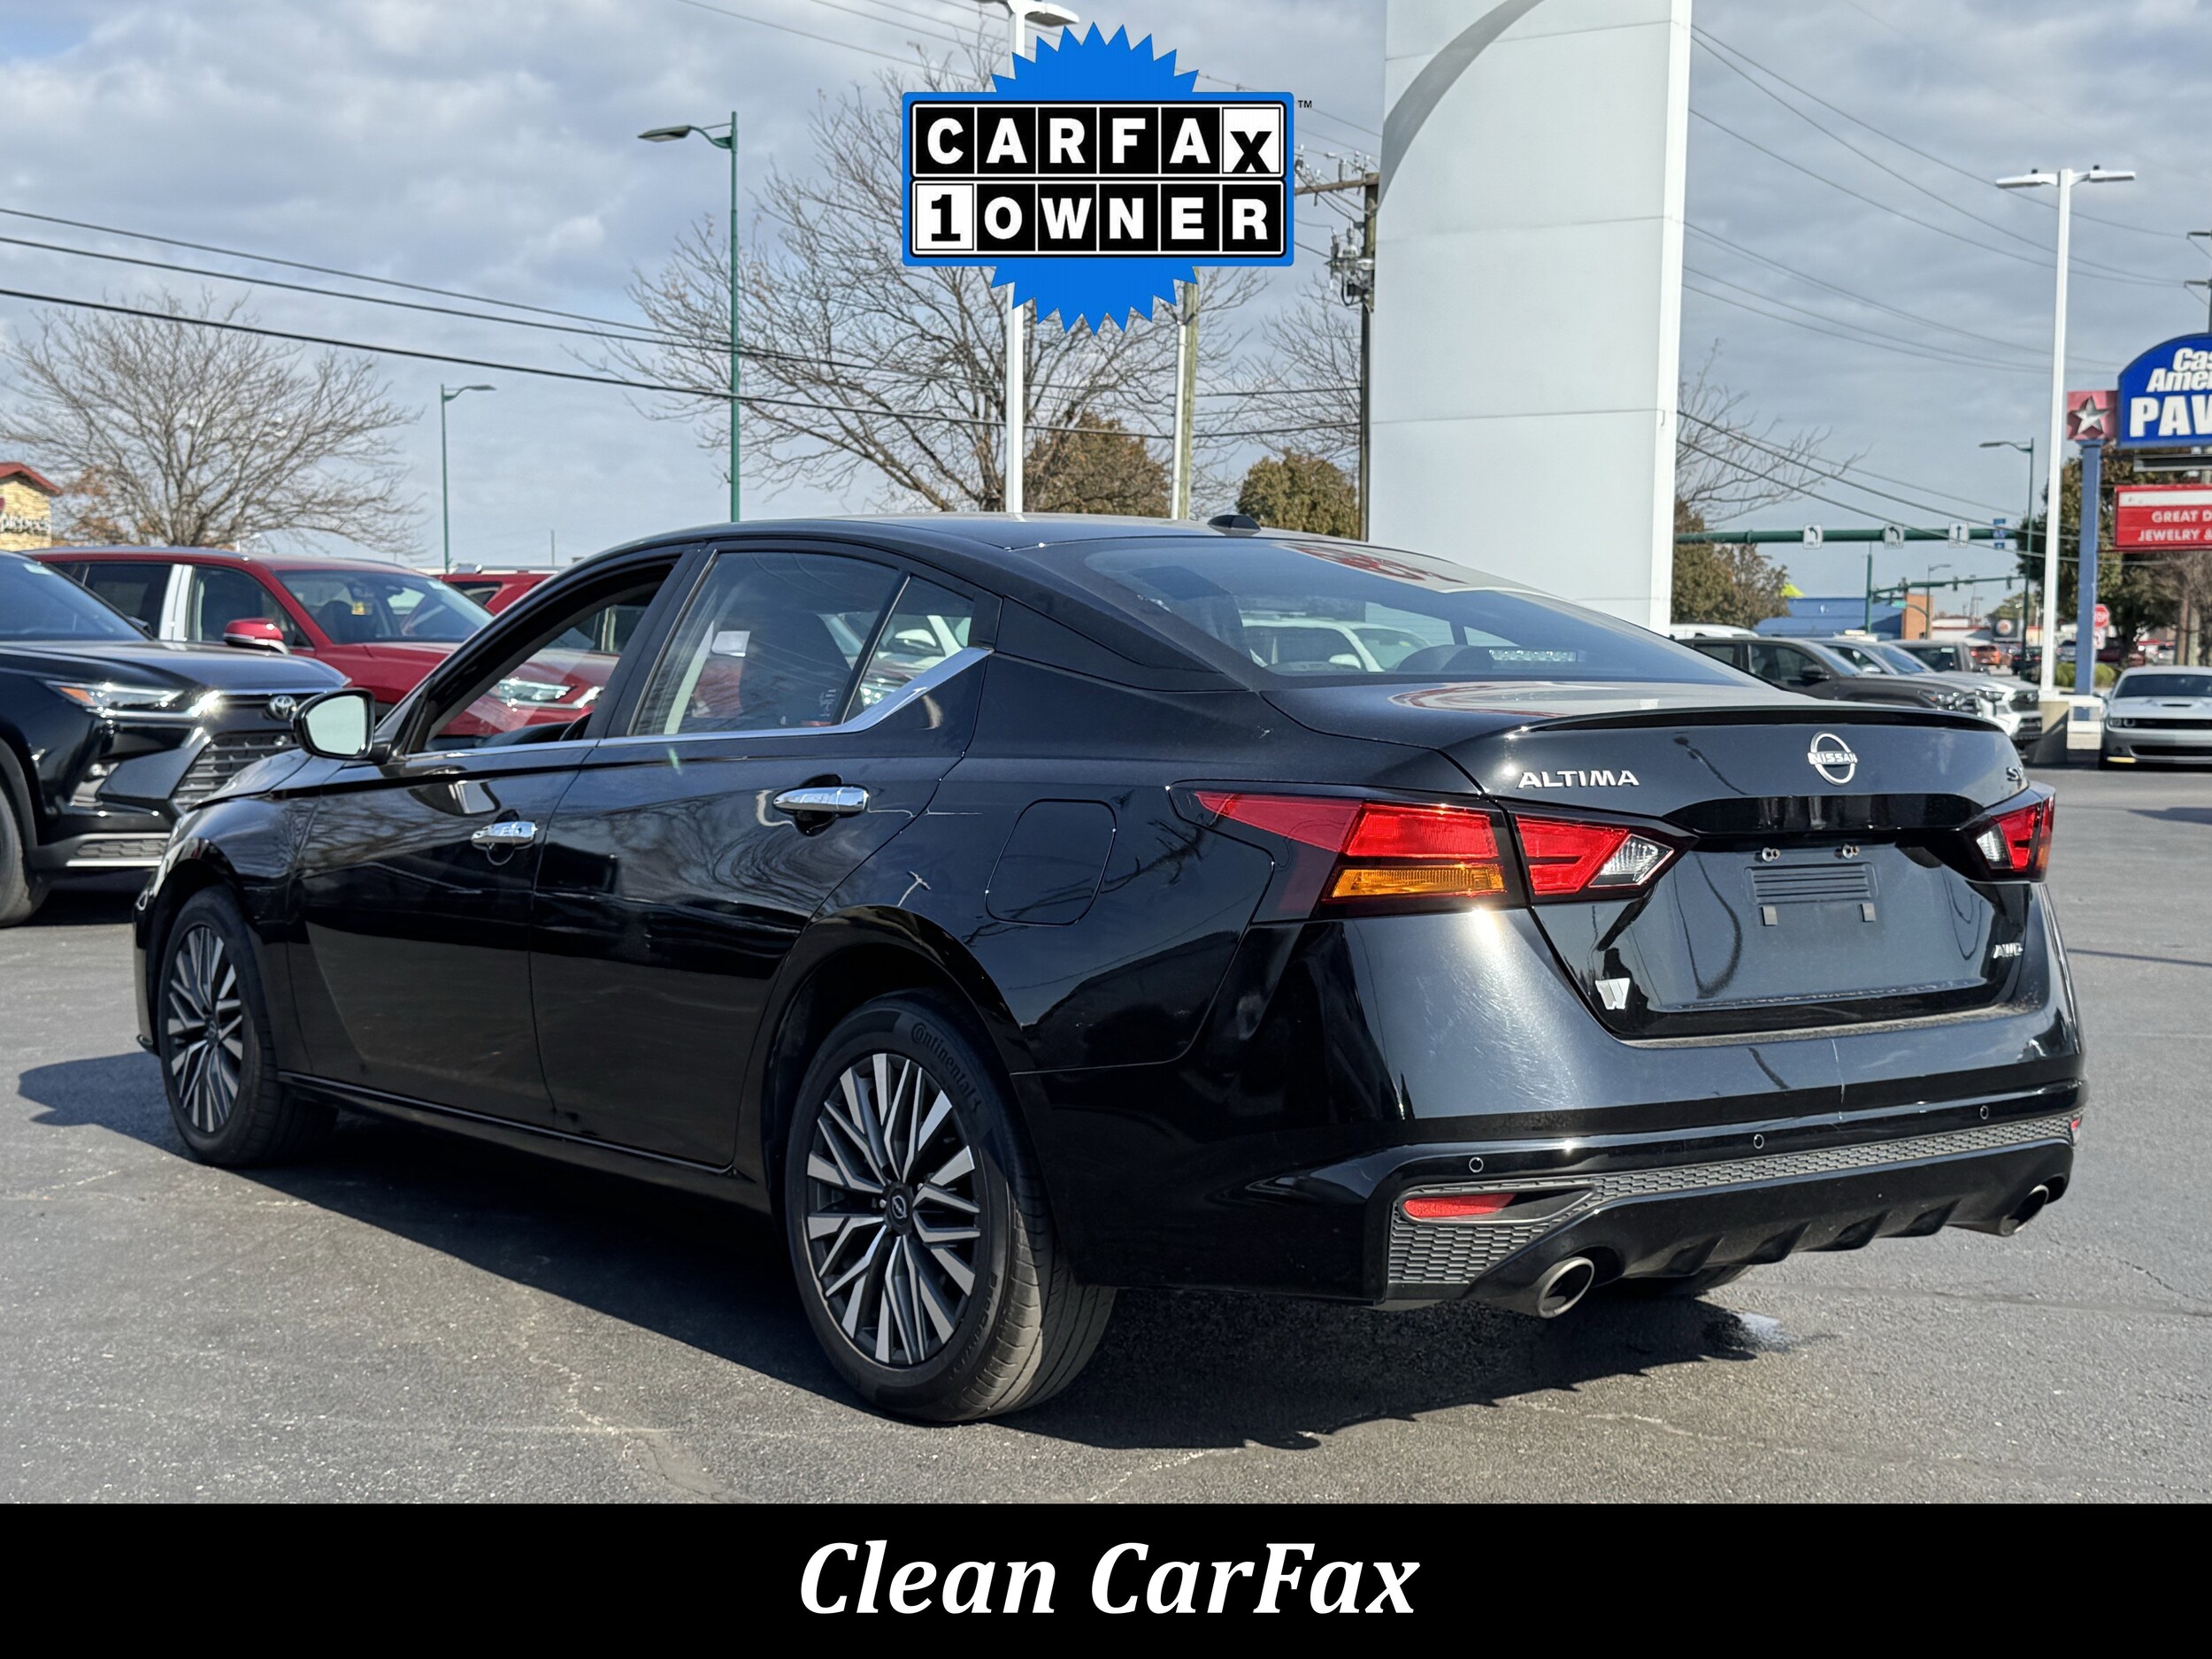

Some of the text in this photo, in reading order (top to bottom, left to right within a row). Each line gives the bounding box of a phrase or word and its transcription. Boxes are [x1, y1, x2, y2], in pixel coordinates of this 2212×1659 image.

[2151, 509, 2199, 524] GREAT
[2138, 528, 2200, 542] JEWELRY
[1807, 751, 1858, 764] NISSAN
[1516, 769, 1640, 789] ALTIMA
